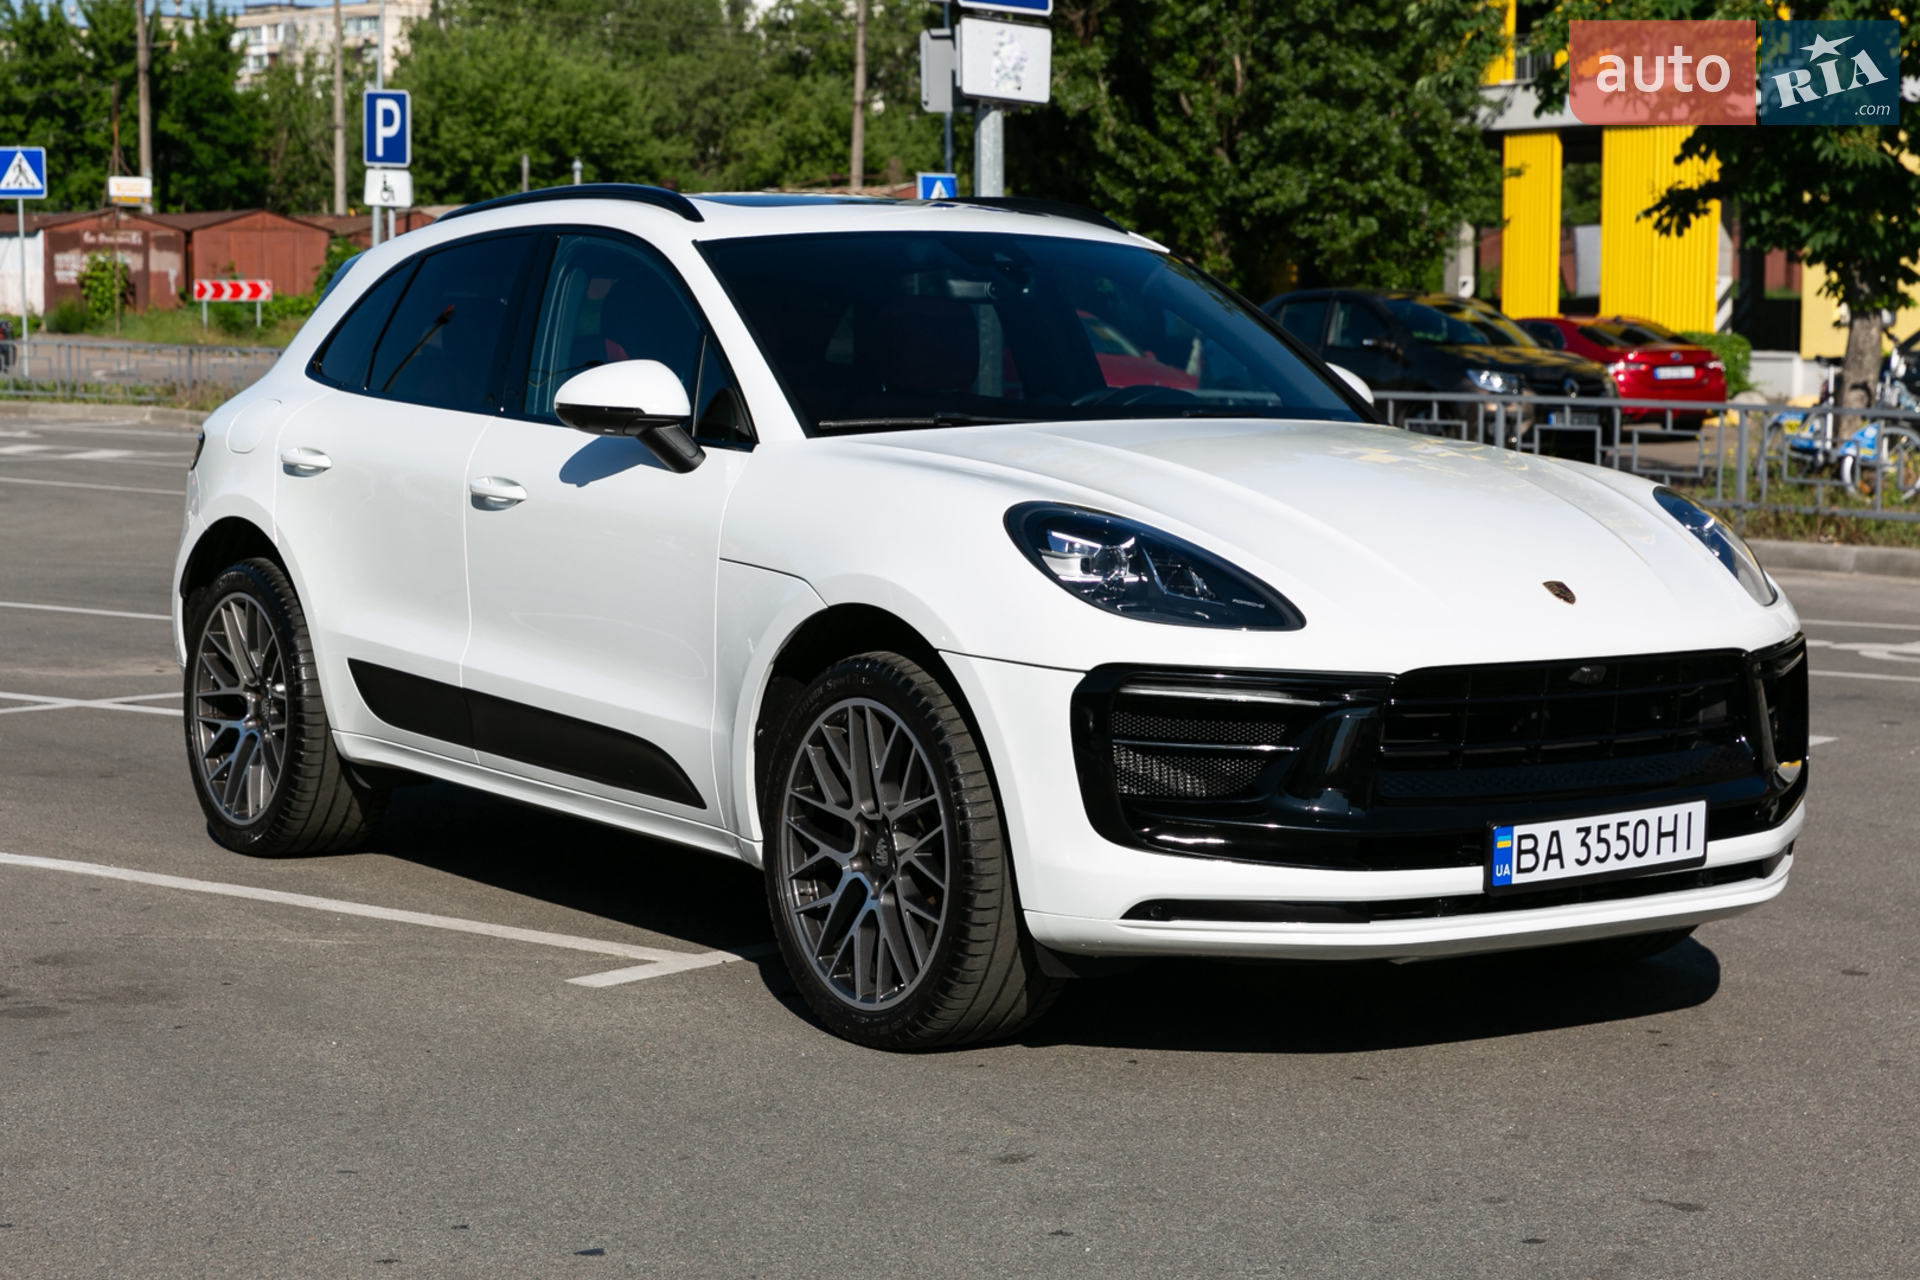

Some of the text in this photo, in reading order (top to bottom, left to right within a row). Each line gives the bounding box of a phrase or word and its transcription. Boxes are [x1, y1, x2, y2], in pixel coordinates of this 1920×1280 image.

[376, 98, 401, 157] P
[1495, 864, 1511, 877] UA
[1516, 830, 1565, 874] BA
